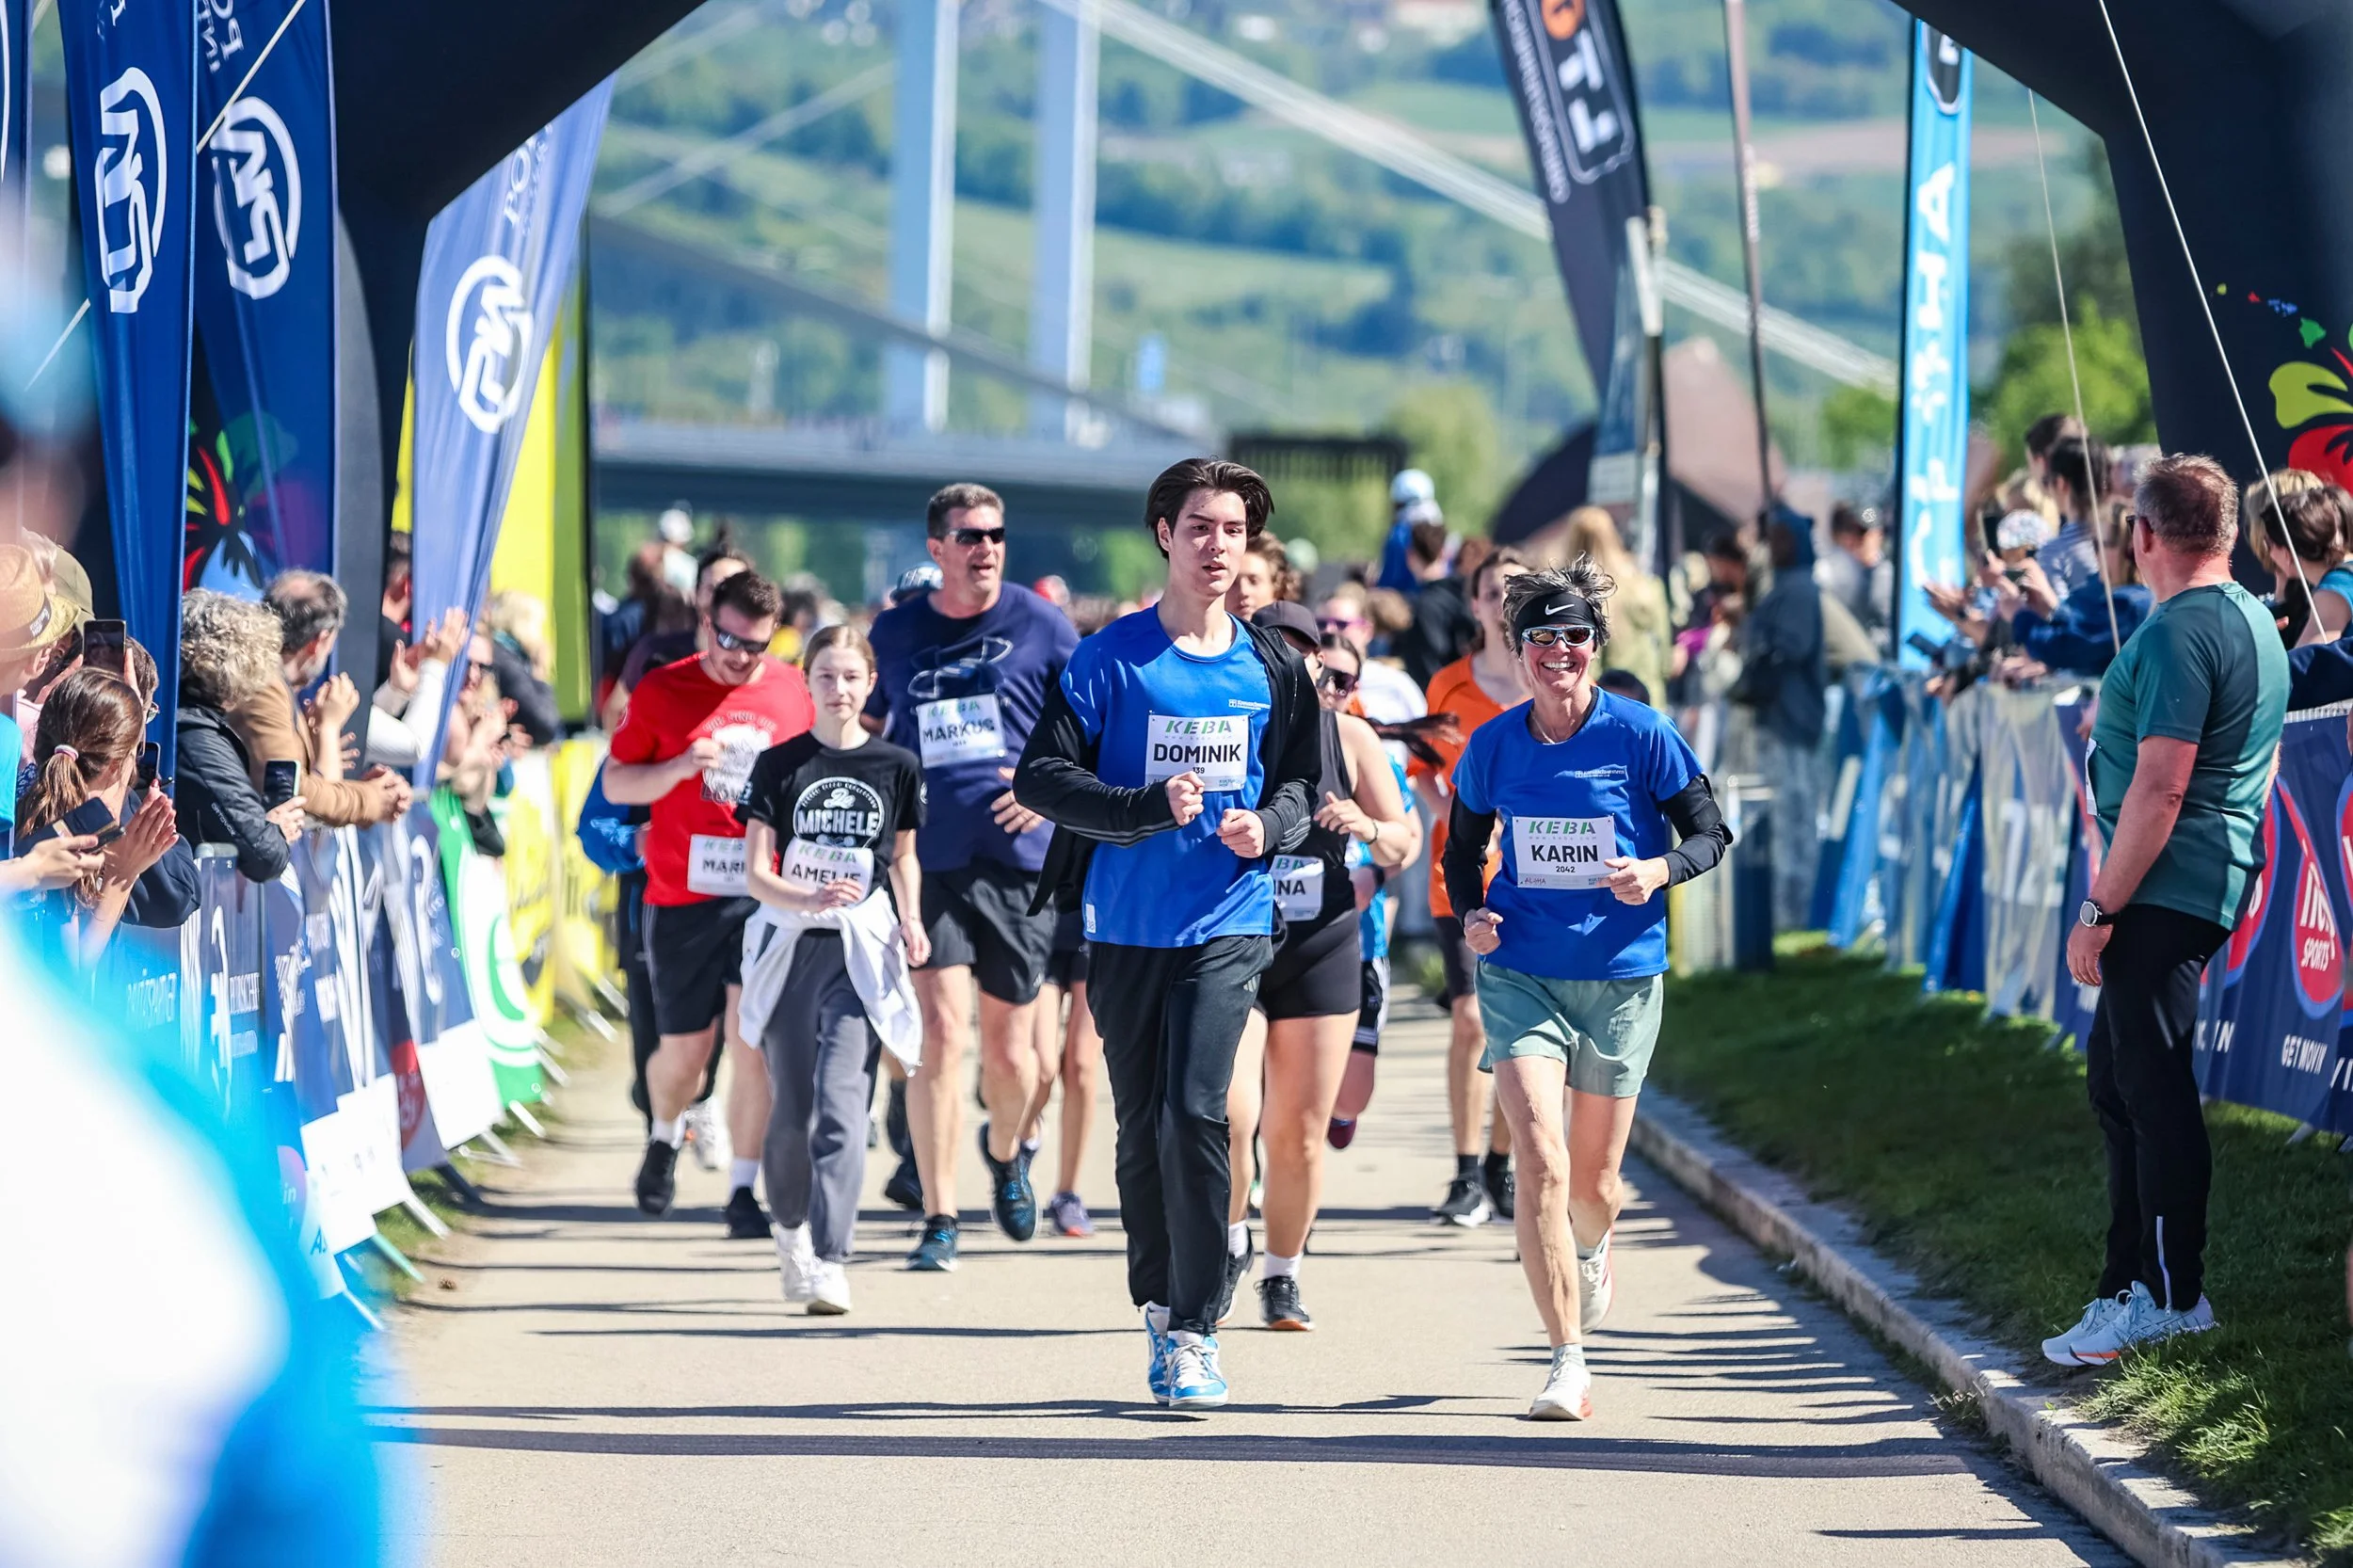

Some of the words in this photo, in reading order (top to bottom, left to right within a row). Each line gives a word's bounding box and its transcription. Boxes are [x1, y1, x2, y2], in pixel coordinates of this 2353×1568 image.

[923, 718, 995, 743] MARKUS
[1165, 720, 1232, 734] KEBA
[1153, 744, 1241, 763] DOMINIK
[211, 802, 235, 836] ORTOVOX
[797, 809, 880, 837] MICHELE
[1529, 821, 1595, 834] KEBA
[705, 840, 744, 854] KEB
[798, 844, 856, 863] KEBA
[1531, 844, 1598, 863] KARIN
[1276, 857, 1304, 870] BA
[2301, 936, 2330, 971] SPORTS
[2281, 1034, 2302, 1068] GET
